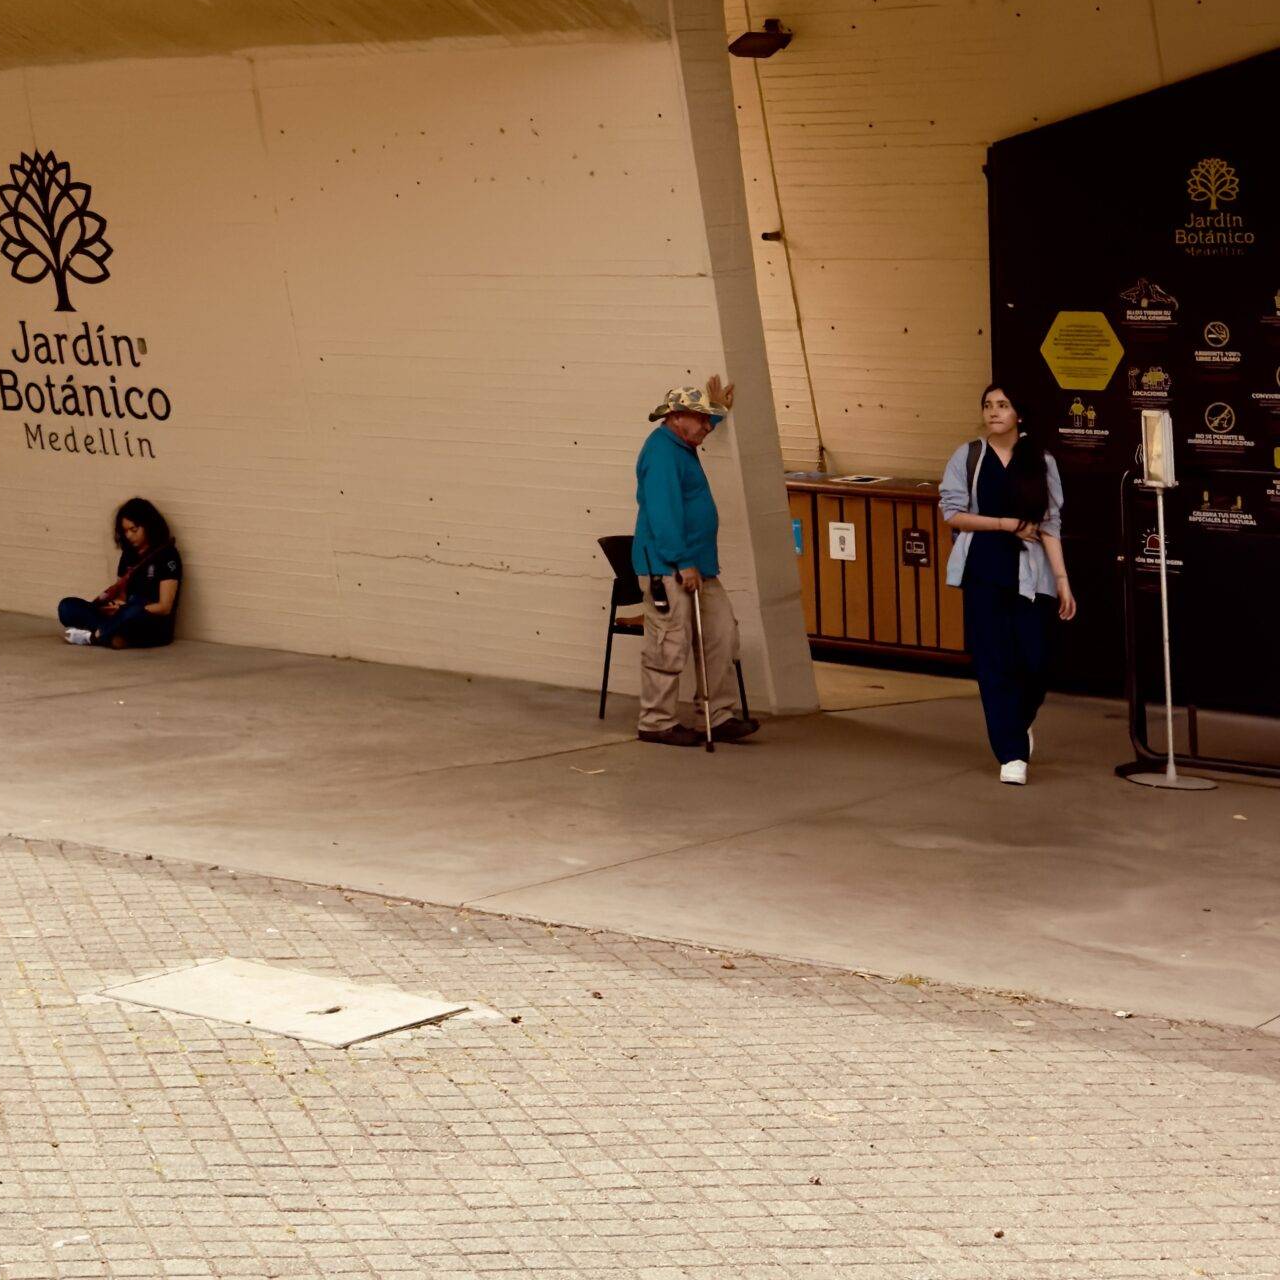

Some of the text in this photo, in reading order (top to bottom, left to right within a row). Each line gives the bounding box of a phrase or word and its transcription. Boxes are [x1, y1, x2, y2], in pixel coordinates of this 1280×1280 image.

[1184, 212, 1244, 228] Jardín
[1175, 229, 1255, 244] Botánico
[11, 320, 141, 368] Jardín
[23, 422, 156, 459] Medellín
